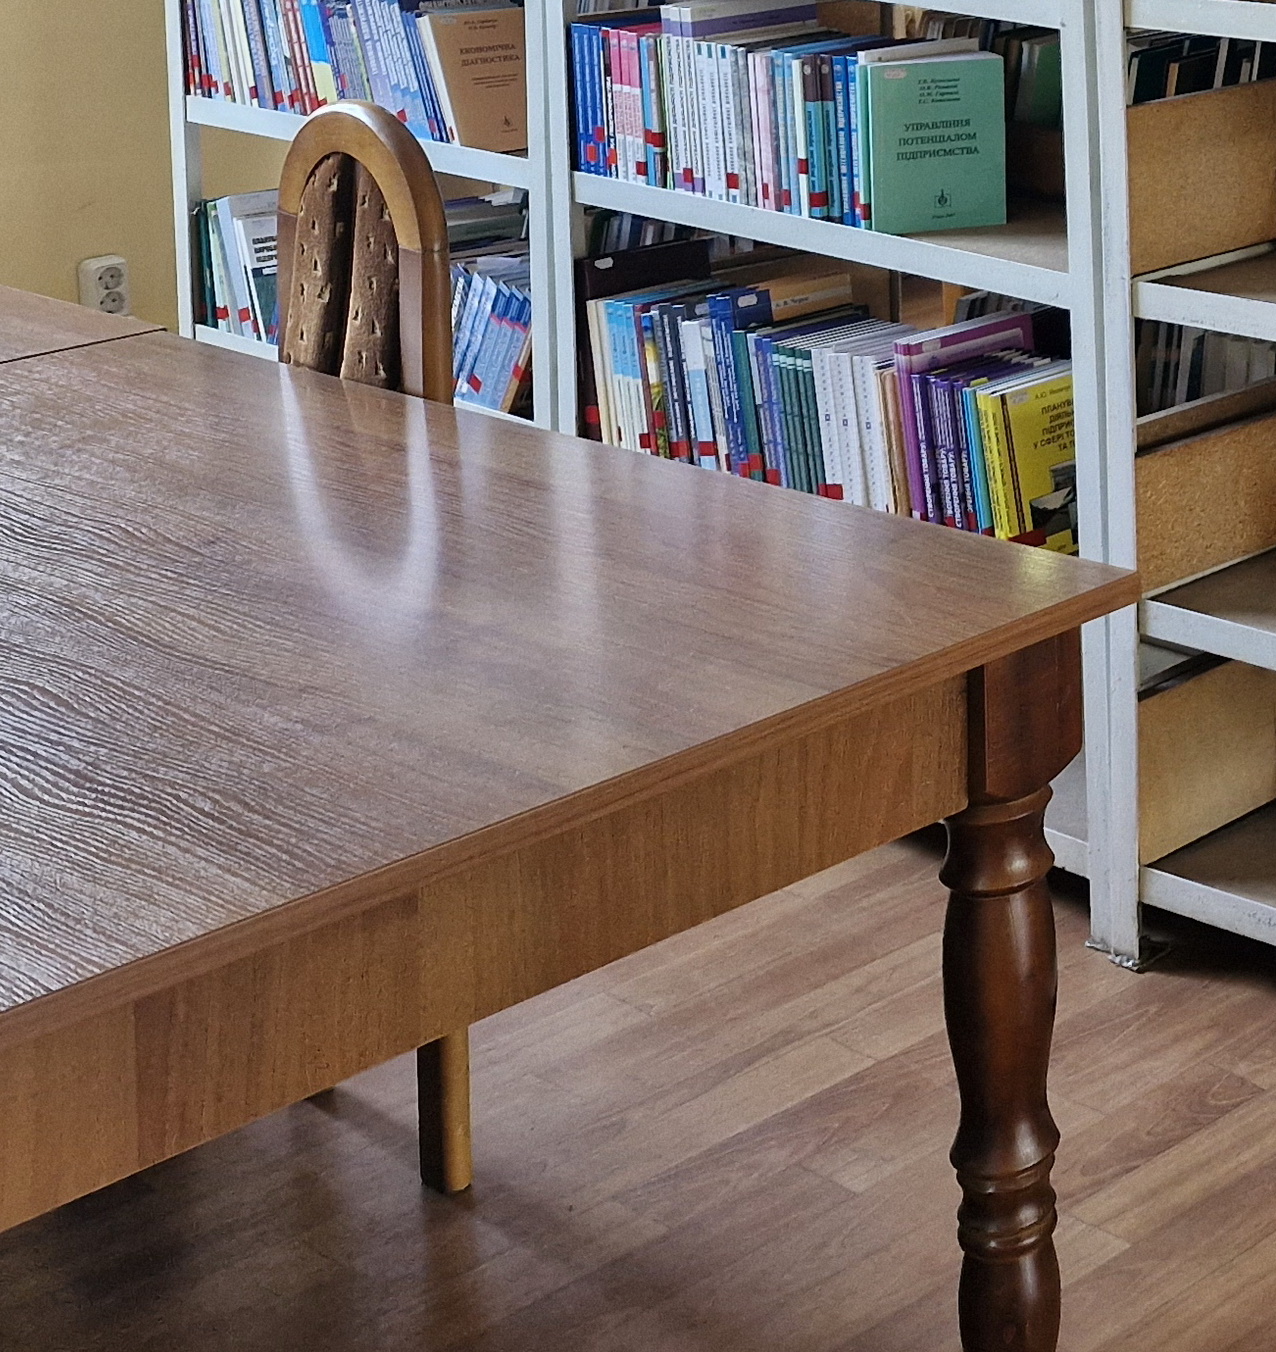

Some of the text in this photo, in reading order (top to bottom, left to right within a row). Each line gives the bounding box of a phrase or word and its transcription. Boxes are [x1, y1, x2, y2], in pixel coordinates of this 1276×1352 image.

[904, 118, 971, 132] УПРАВЛІННЯ
[898, 132, 977, 147] ПОТЕНЦІАЛОМ
[897, 146, 980, 161] ПІДПРИЄМСТВА
